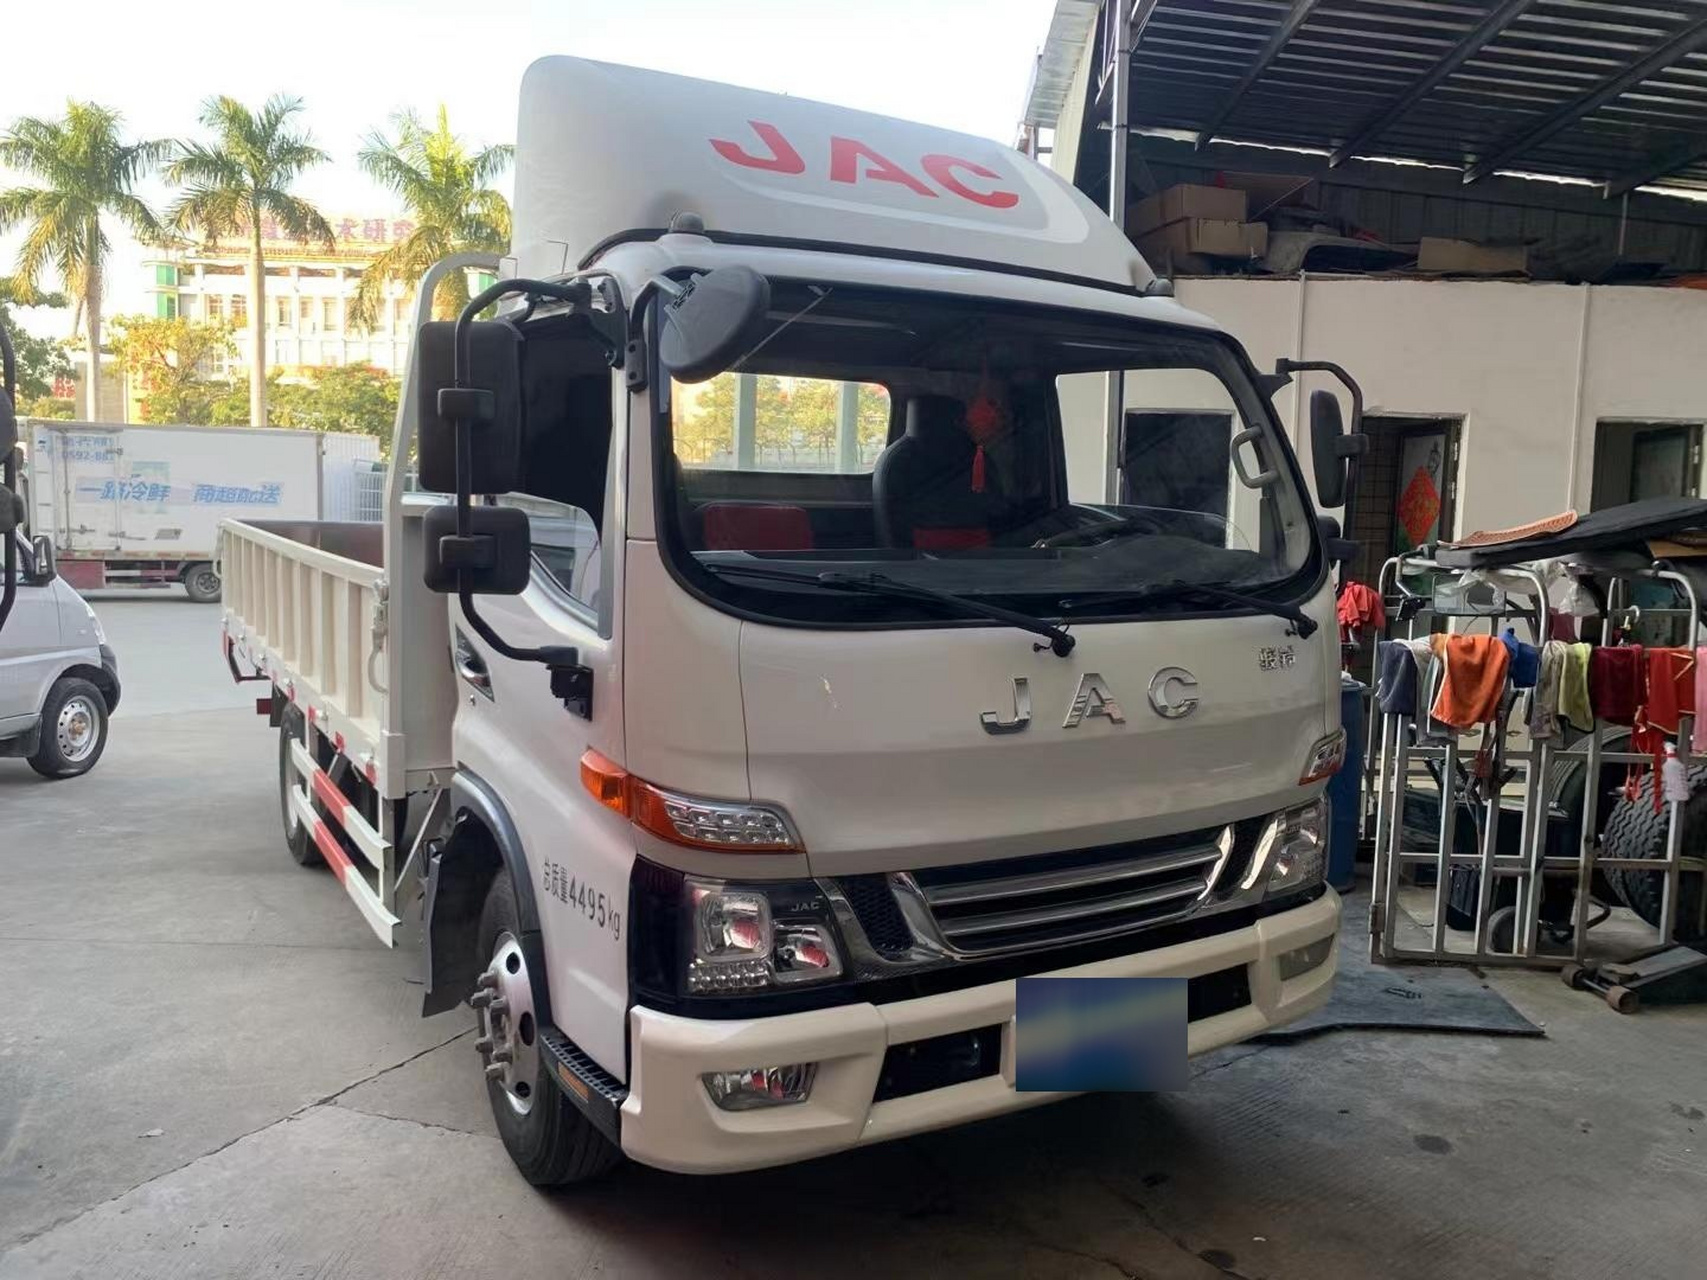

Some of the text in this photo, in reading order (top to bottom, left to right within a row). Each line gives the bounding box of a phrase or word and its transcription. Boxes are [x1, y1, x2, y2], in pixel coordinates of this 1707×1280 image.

[708, 119, 1019, 209] JAC
[980, 667, 1199, 735] JAC
[791, 901, 820, 912] JAC
